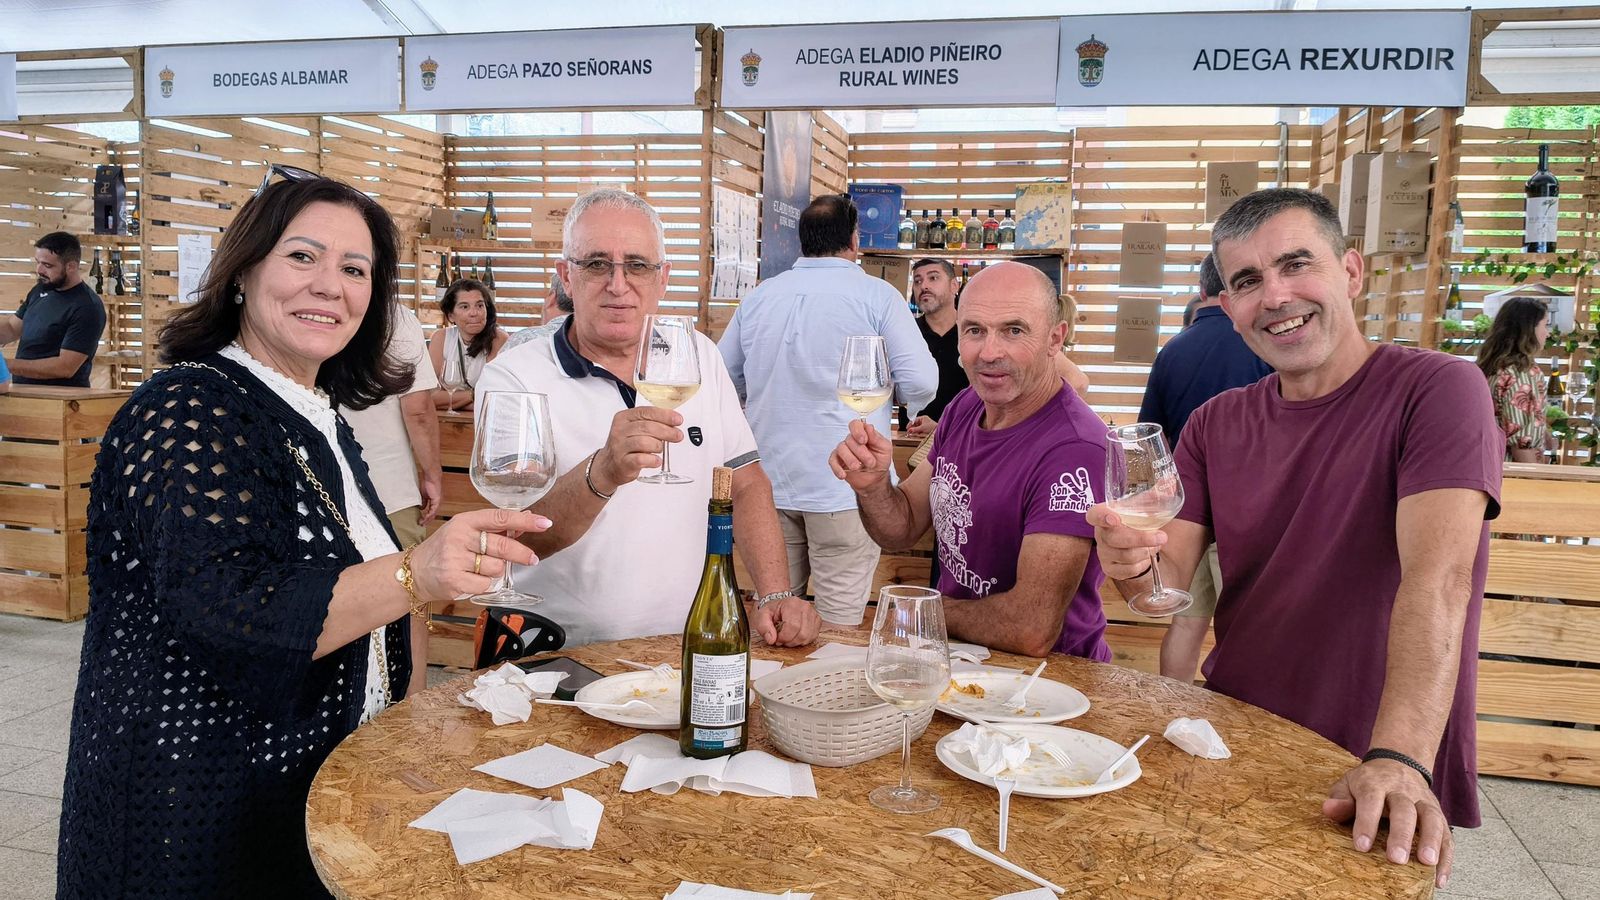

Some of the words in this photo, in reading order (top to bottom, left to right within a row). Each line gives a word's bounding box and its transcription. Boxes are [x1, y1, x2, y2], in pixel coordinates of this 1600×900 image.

[796, 47, 855, 64] ADEGA
[860, 45, 925, 64] ELADIO
[930, 42, 1002, 62] PIÑEIRO
[1193, 48, 1291, 71] ADEGA
[1300, 47, 1455, 71] REXURDIR
[213, 71, 278, 87] BODEGAS
[281, 69, 349, 86] ALBAMAR
[467, 63, 519, 80] ADEGA
[522, 61, 563, 78] PAZO
[567, 57, 652, 77] SEÑORANS
[839, 70, 898, 87] RURAL
[902, 68, 959, 86] WINES
[1051, 483, 1070, 497] Son
